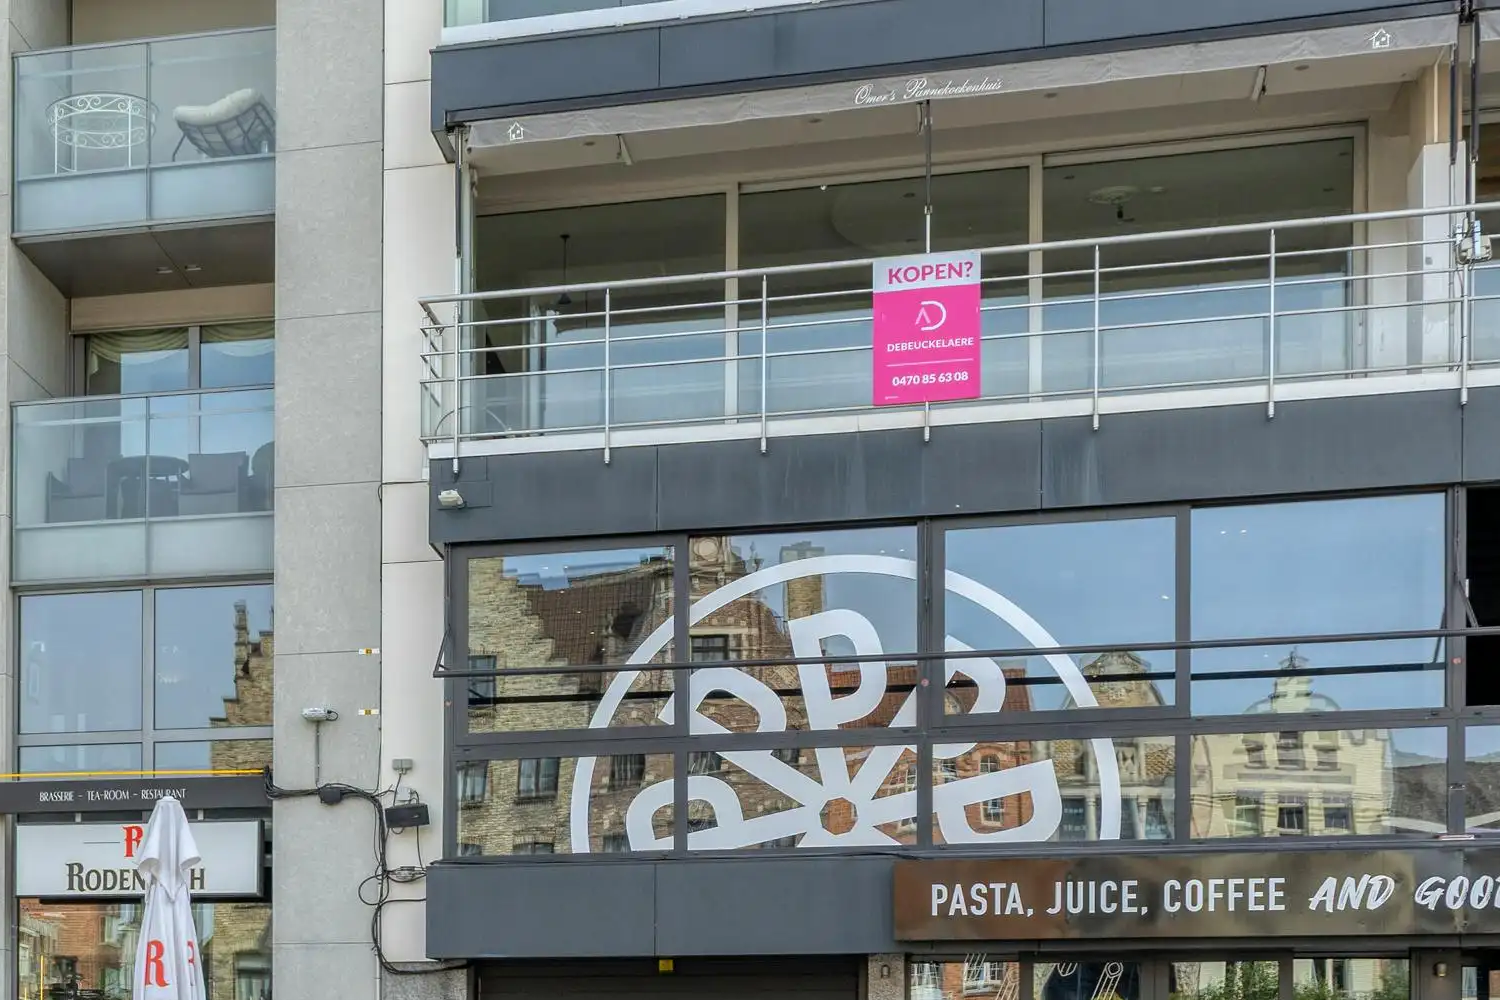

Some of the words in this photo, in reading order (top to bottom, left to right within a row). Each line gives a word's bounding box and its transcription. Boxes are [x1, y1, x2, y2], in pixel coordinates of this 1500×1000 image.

[854, 83, 896, 105] Omer's
[903, 77, 1004, 100] Pannekoekenhuis
[888, 261, 973, 285] KOPEN?
[886, 337, 974, 352] DEBEUCKELAERE
[892, 375, 920, 387] 0470
[922, 373, 936, 385] 85
[938, 372, 953, 383] 63
[953, 371, 969, 382] 08
[39, 790, 74, 802] BRASSERIE
[87, 789, 130, 801] TEA-ROOM
[65, 862, 206, 892] RODENH
[931, 882, 1034, 918] PASTA,
[1046, 880, 1149, 916] JUICE,
[1164, 877, 1286, 912] COFFEE
[1308, 873, 1395, 913] AND
[144, 939, 170, 988] R
